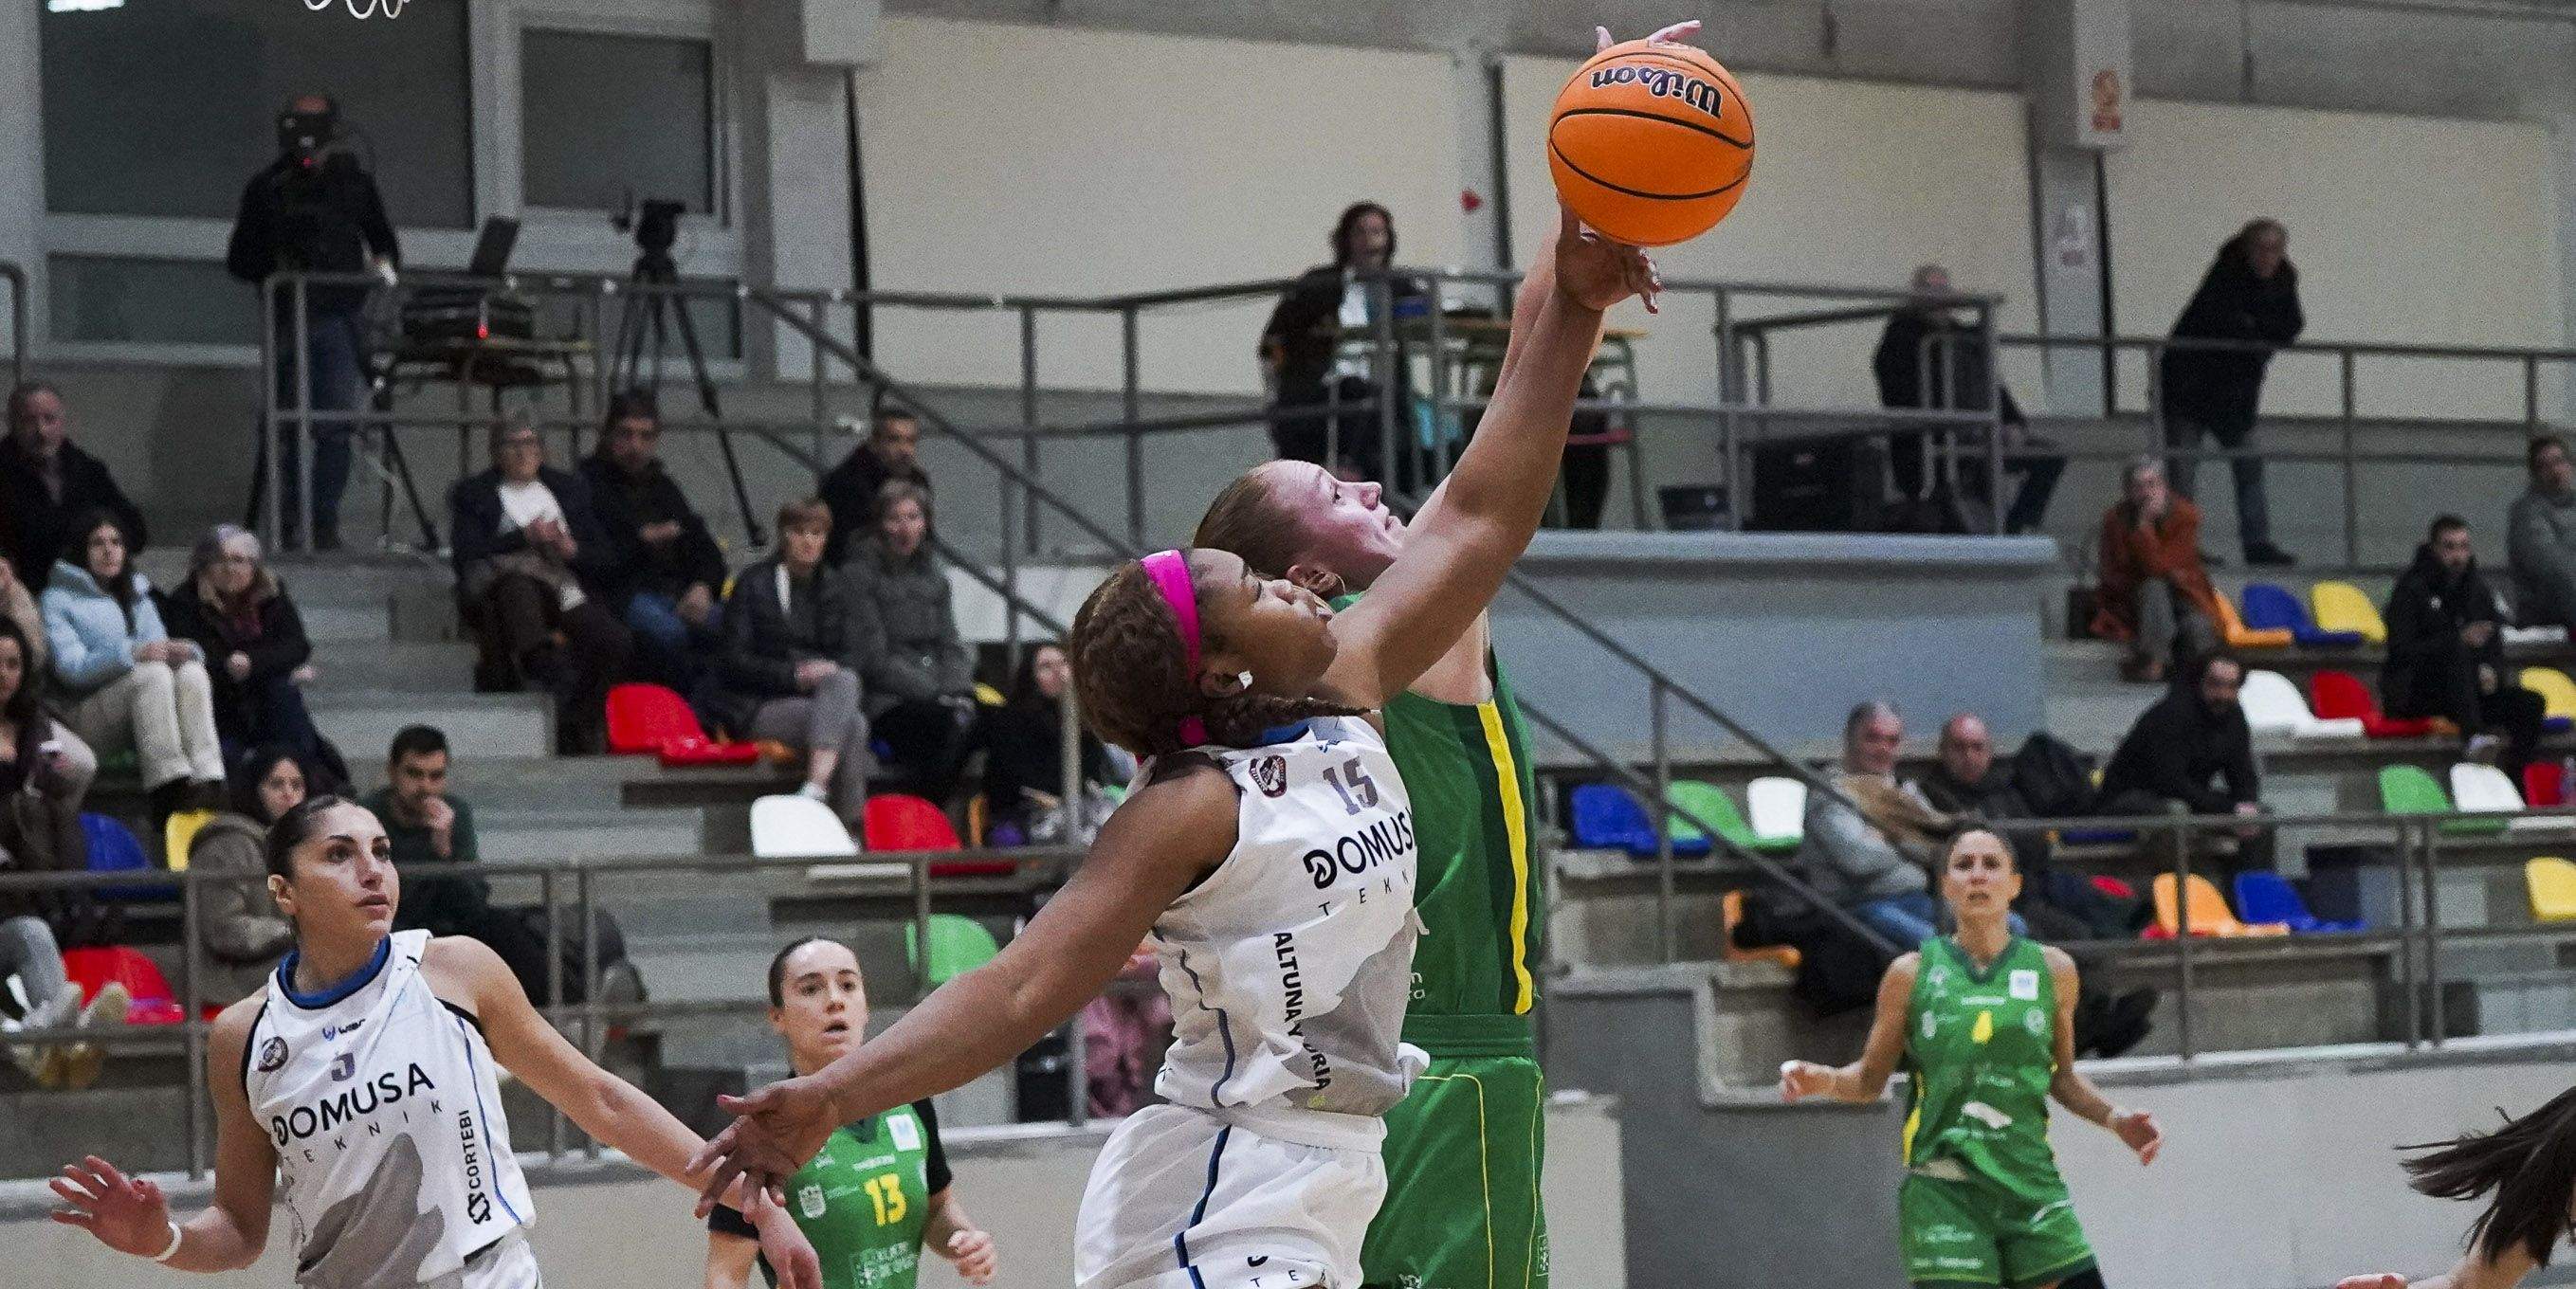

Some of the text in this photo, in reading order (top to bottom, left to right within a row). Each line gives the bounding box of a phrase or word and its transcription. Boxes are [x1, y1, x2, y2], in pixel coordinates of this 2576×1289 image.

[1590, 65, 1723, 119] Wilson
[1322, 755, 1379, 816] 15
[1273, 932, 1304, 1023] ALTUNA
[1288, 1022, 1305, 1037] Y
[271, 1062, 435, 1148] DOMUSA
[283, 1099, 444, 1169] TEKNIK
[458, 1109, 482, 1189] CORTEBI
[864, 1172, 907, 1227] 13
